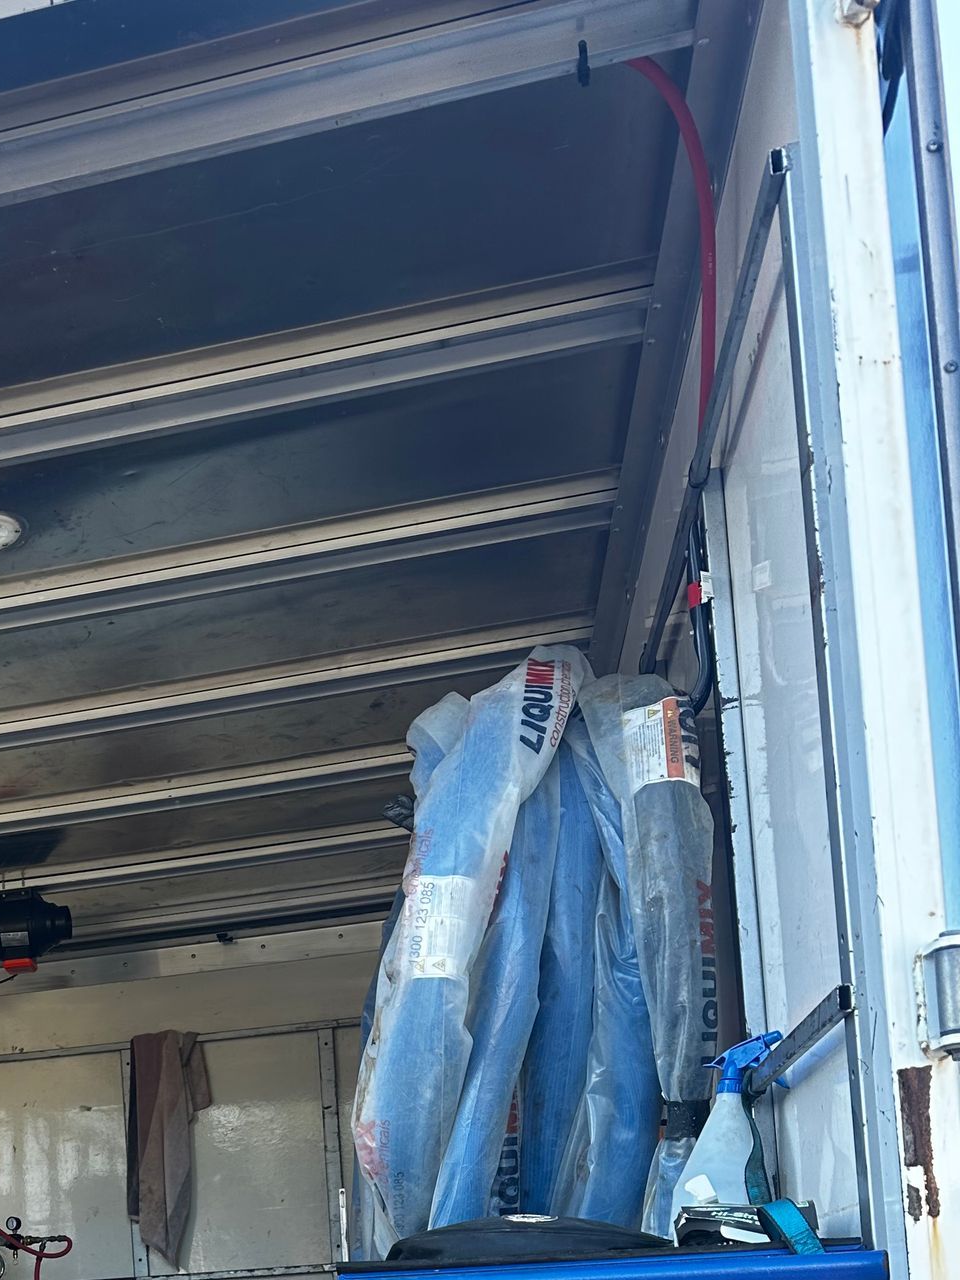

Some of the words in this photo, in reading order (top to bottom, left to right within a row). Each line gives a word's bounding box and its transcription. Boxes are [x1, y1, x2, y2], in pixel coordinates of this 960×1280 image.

[520, 658, 556, 755] LIQUIMIX
[667, 719, 680, 764] WARNING
[419, 881, 435, 905] 085
[415, 908, 429, 931] 123
[409, 935, 423, 966] 1300
